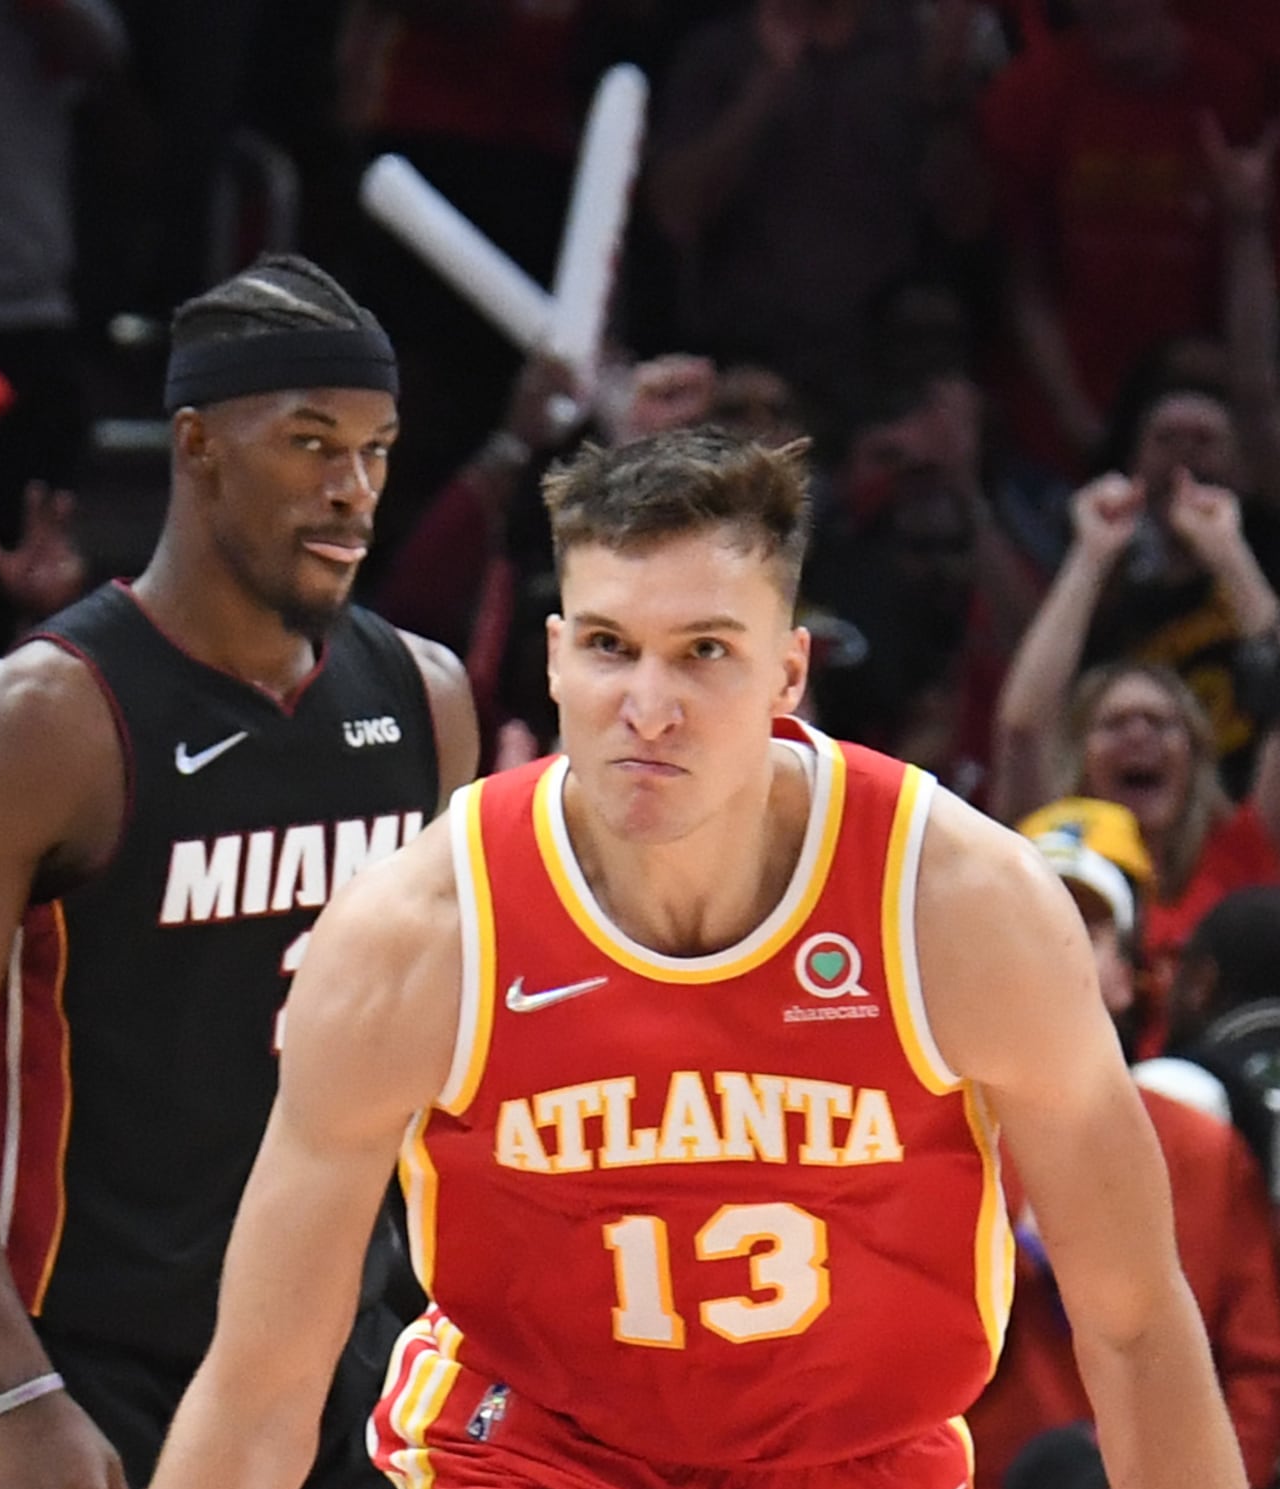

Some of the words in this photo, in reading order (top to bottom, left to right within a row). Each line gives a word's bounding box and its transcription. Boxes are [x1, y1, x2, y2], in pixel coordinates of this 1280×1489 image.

[157, 810, 424, 926] MIAM
[783, 1004, 880, 1023] sharecare
[493, 1070, 905, 1175] ATLANTA
[602, 1202, 831, 1350] 13
